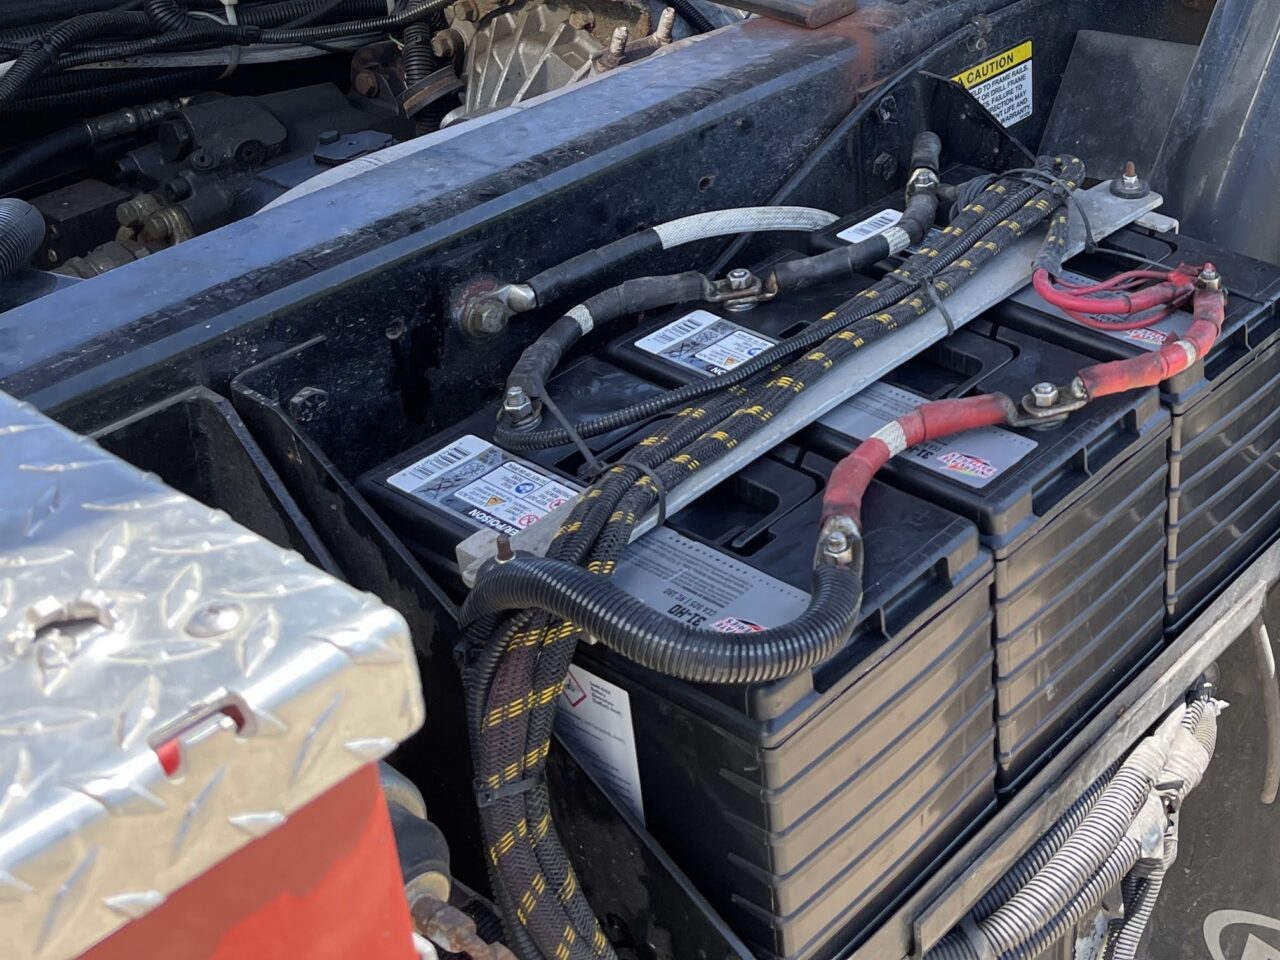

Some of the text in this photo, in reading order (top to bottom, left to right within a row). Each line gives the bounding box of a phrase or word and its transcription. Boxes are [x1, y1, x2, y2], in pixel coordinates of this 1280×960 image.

[967, 53, 1013, 83] CAUTION
[971, 87, 981, 97] ELD
[983, 83, 990, 91] TO
[992, 73, 1010, 86] FRAME
[981, 92, 989, 100] OR
[991, 84, 1005, 95] DRILL
[1007, 73, 1025, 87] FRAME
[991, 87, 1014, 103] FAILURE
[1015, 83, 1022, 91] TO
[989, 96, 1013, 113] RECTION
[1015, 89, 1026, 100] MAY
[1004, 104, 1014, 114] LIFE
[1016, 97, 1027, 107] AND
[468, 508, 520, 536] ER/POISON
